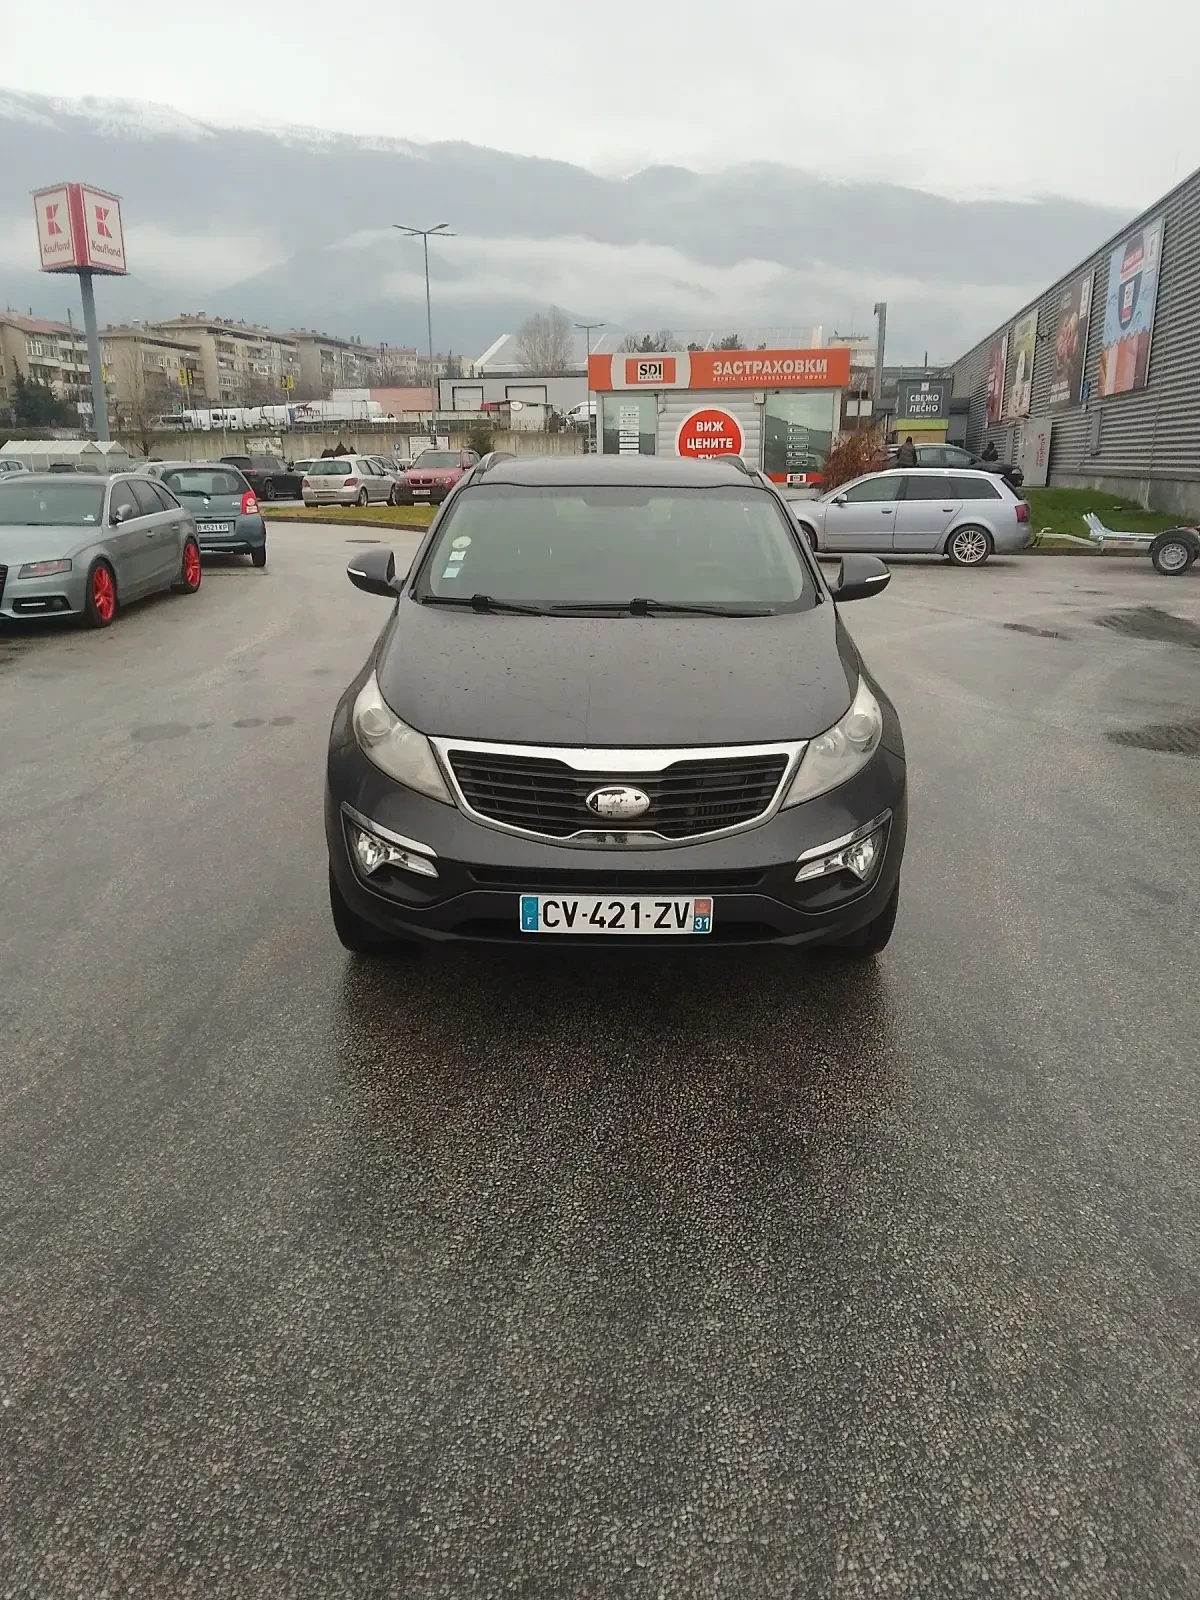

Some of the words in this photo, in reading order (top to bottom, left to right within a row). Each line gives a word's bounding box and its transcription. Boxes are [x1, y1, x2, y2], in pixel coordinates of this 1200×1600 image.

[43, 239, 70, 256] Kaufland
[91, 240, 121, 257] Kaufland
[640, 364, 662, 376] SDI
[713, 359, 827, 375] ЗАСТРАХОВКИ
[910, 394, 940, 402] СВЕЖО
[909, 405, 939, 413] ЛЕСНО
[696, 421, 724, 432] ВИЖ
[686, 438, 733, 450] ЦЕНИТЕ
[542, 900, 690, 929] CV-421-ZV
[695, 917, 710, 930] 31
